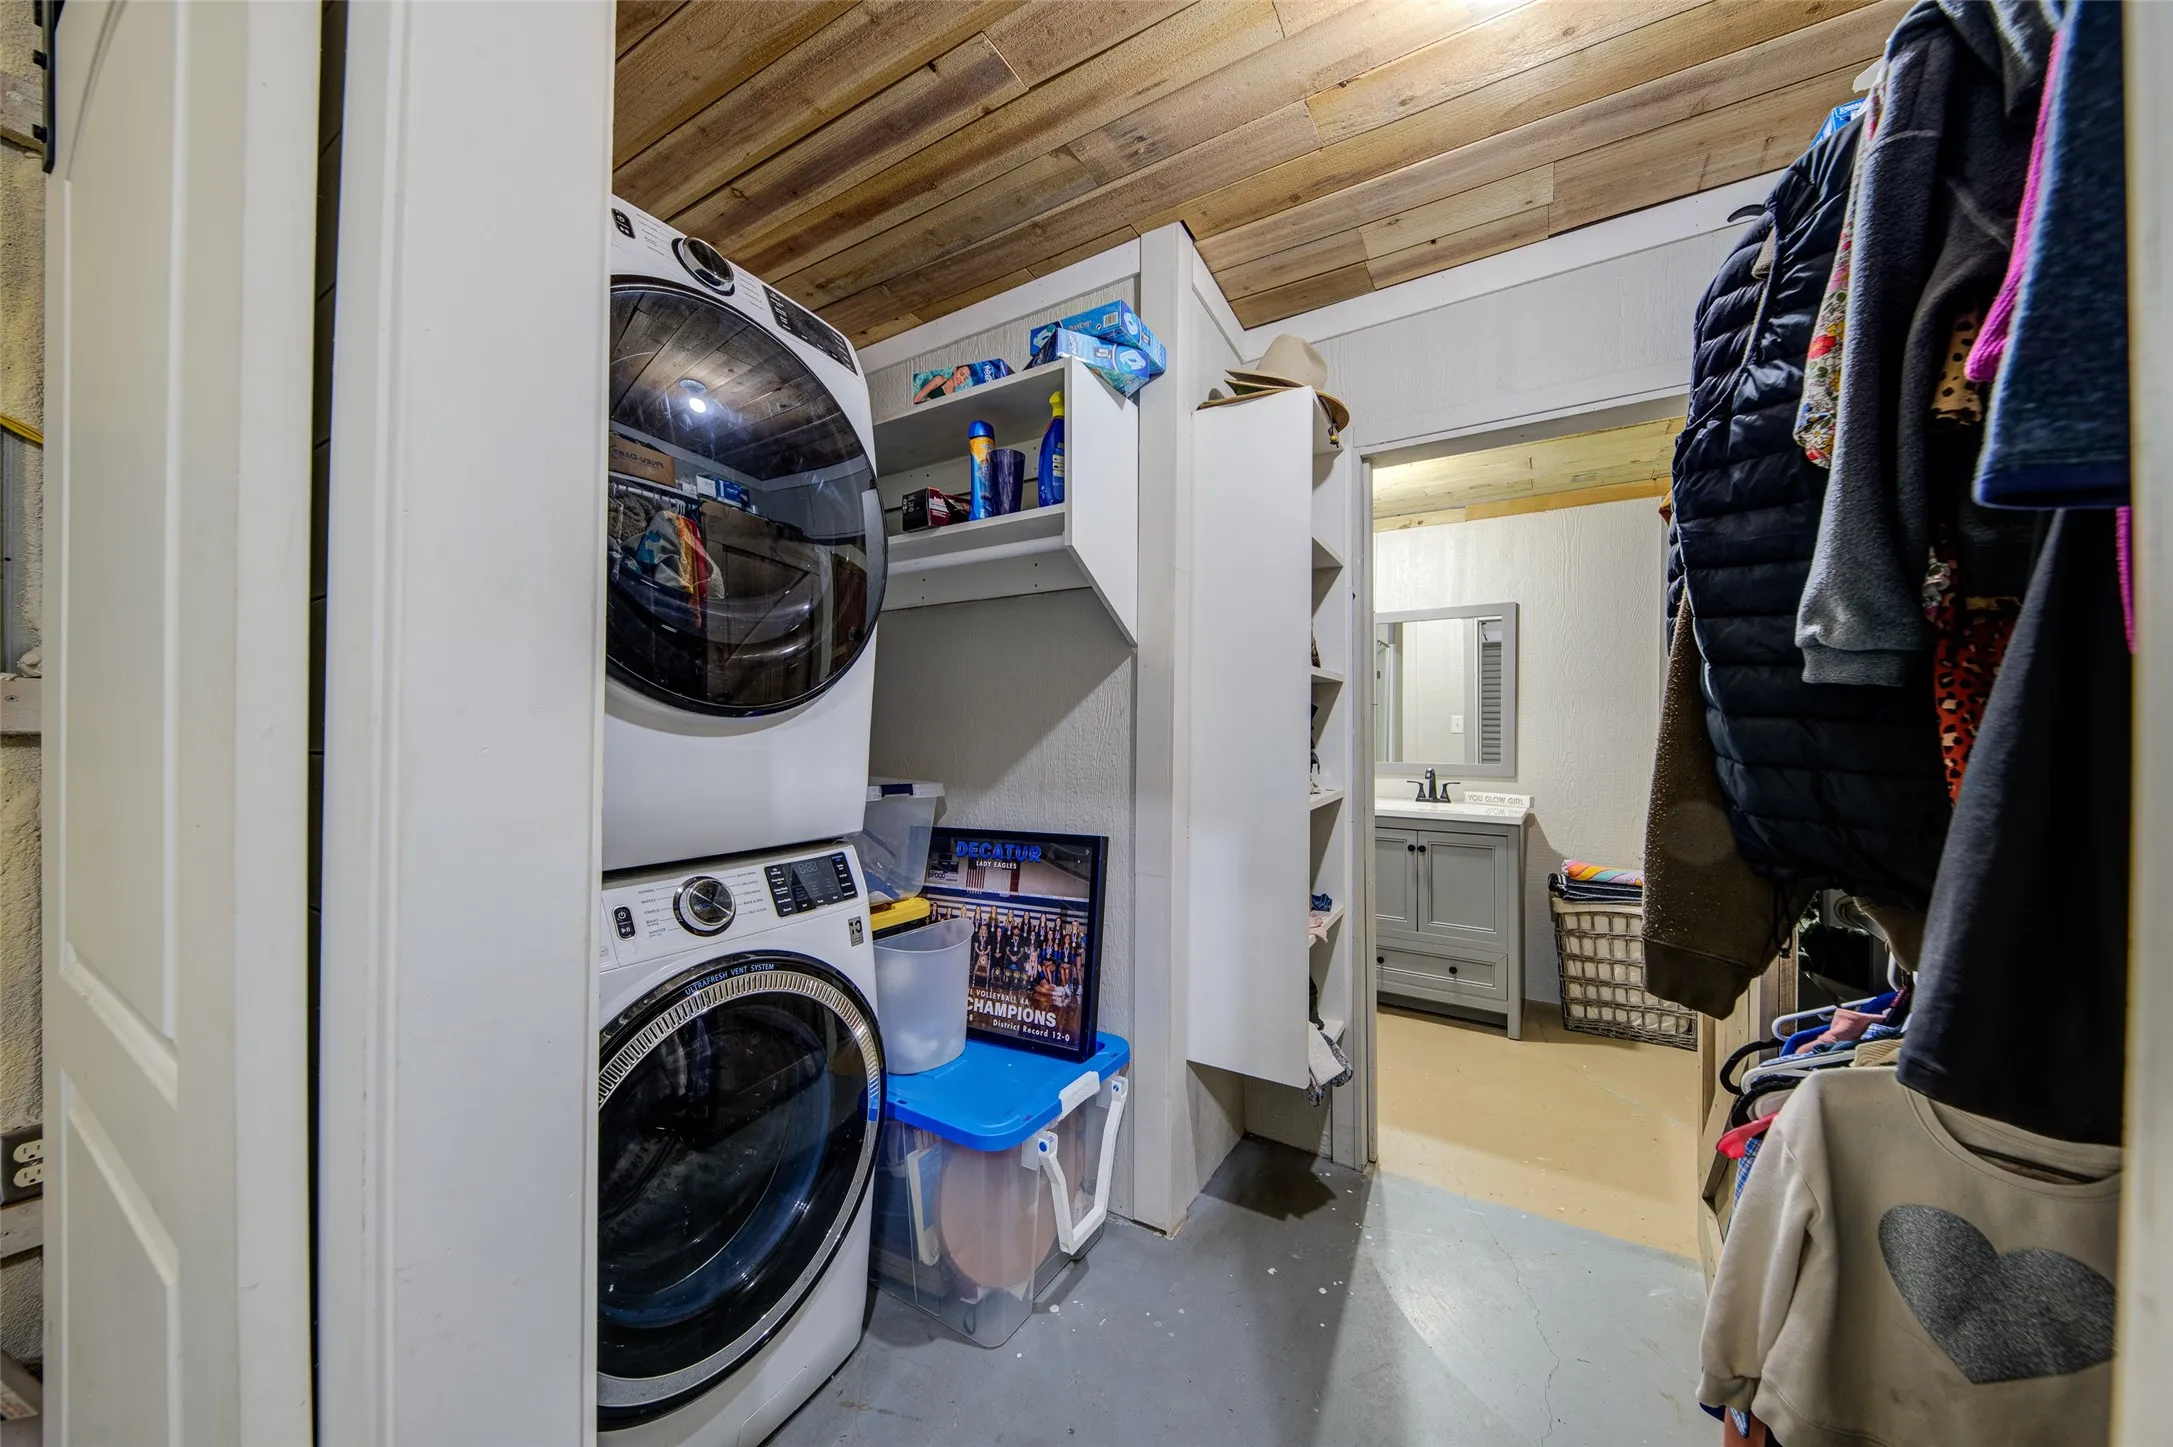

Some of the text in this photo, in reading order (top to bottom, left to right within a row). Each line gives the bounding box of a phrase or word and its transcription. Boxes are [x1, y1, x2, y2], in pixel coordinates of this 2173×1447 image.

[1468, 794, 1524, 805] YOU GLOW GIRL
[956, 841, 1042, 864] DECATUR
[993, 861, 1017, 870] EAGLES
[685, 963, 775, 995] ULTRAFRESH VENT SYSTEM
[976, 989, 1017, 1004] VOLLEYBALL
[1020, 997, 1029, 1006] 4A
[967, 997, 1056, 1028] CHAMPIONS
[993, 1019, 1020, 1031] District
[1023, 1025, 1048, 1038] Record
[1052, 1031, 1070, 1042] 12-0
